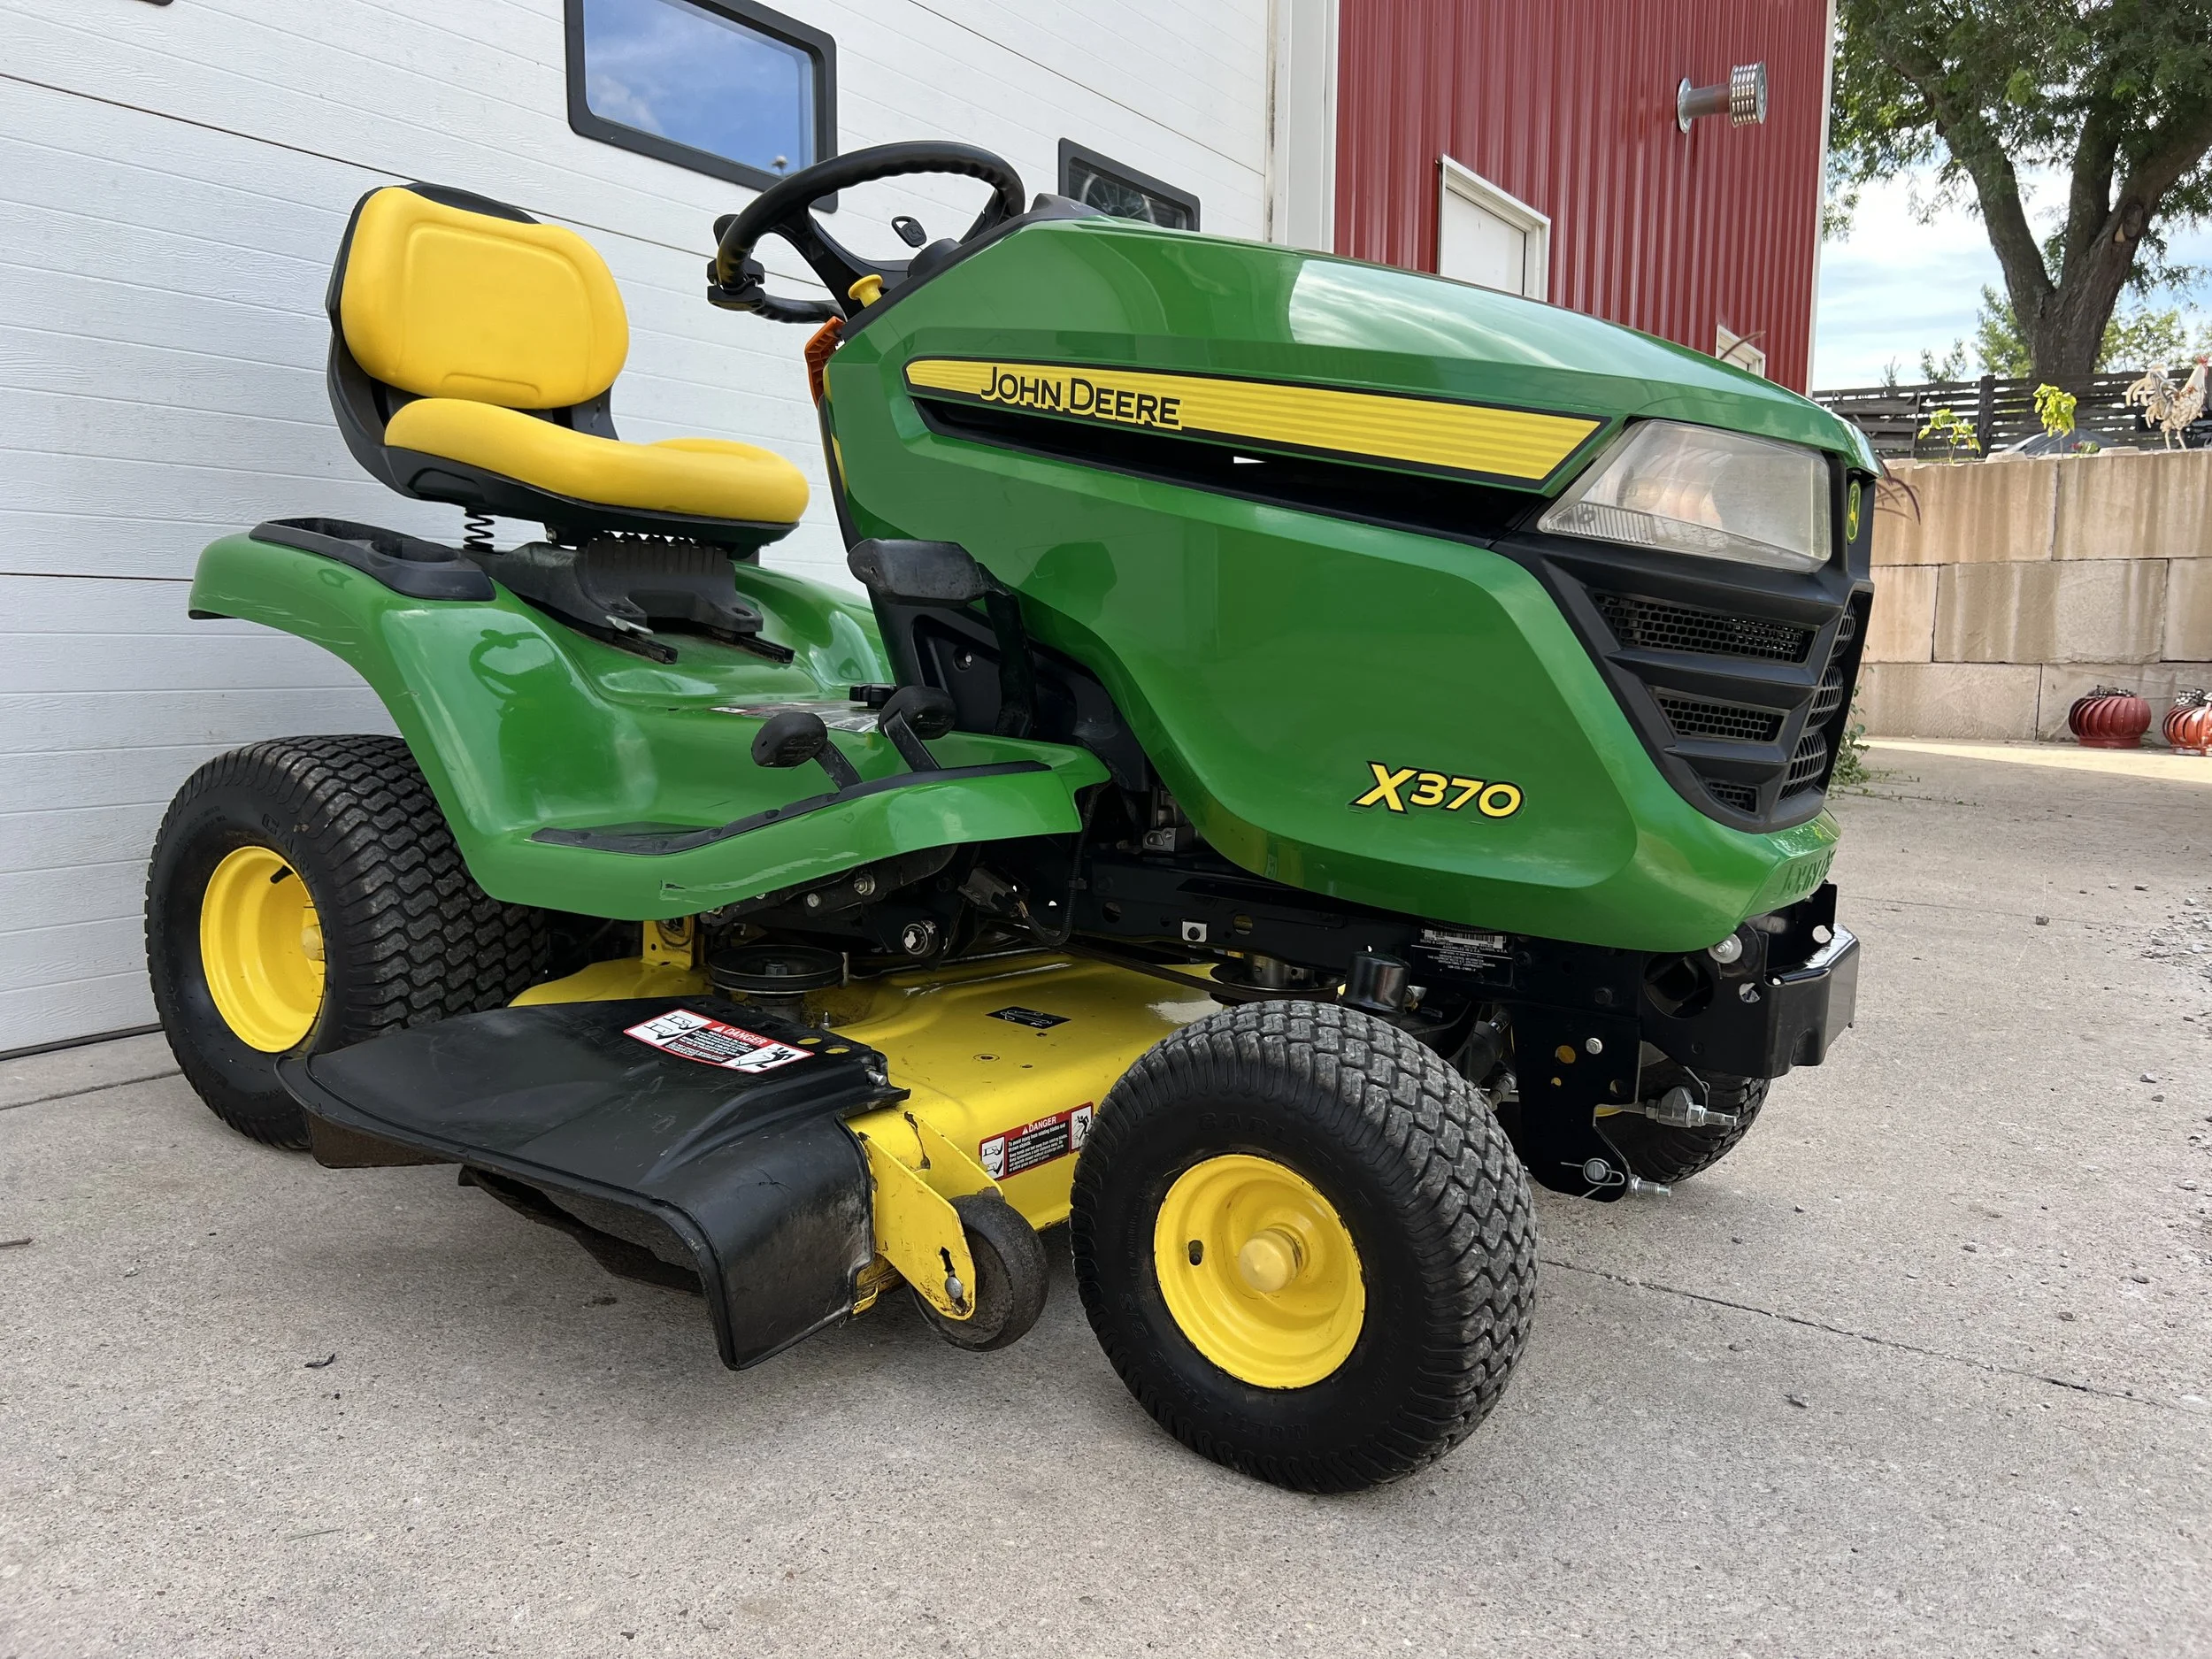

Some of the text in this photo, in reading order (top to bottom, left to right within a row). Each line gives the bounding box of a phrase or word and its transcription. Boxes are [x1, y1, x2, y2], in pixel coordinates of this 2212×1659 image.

[980, 366, 1181, 428] JOHN DEERE
[1348, 761, 1523, 819] X370
[723, 1028, 768, 1045] DANGER
[1029, 1117, 1056, 1133] DANGER
